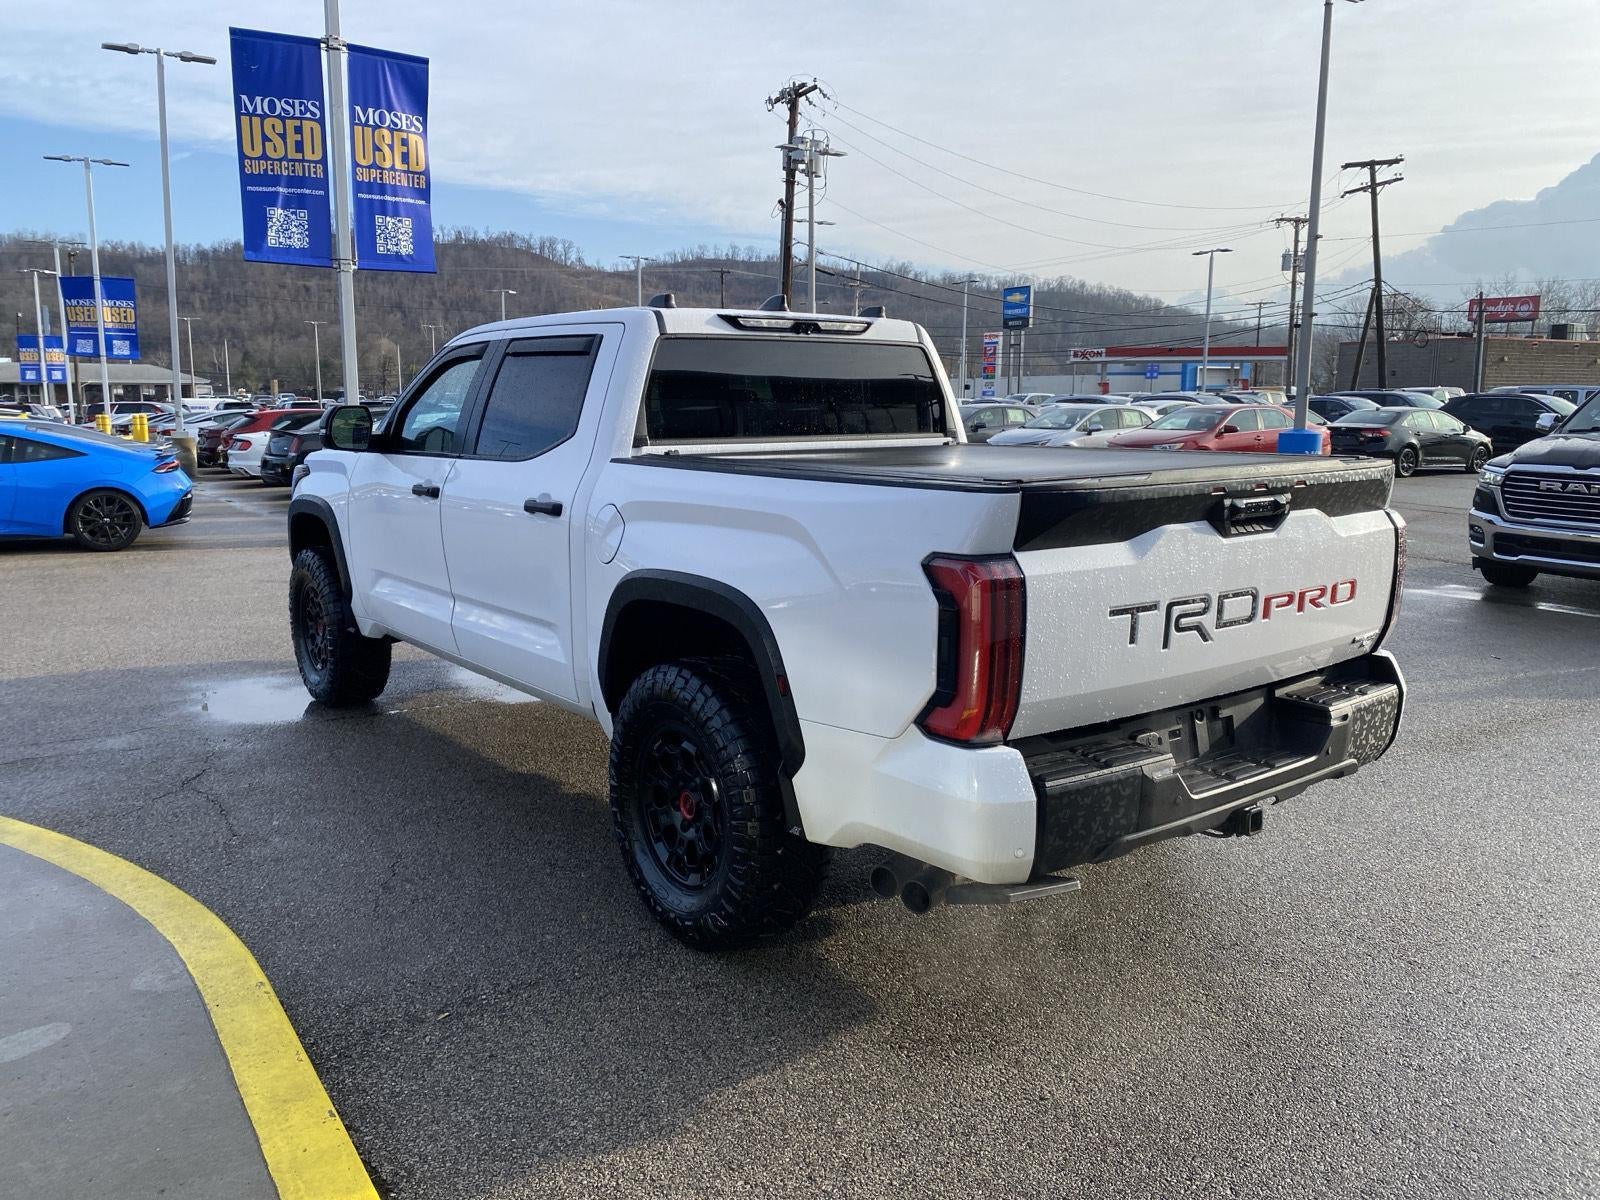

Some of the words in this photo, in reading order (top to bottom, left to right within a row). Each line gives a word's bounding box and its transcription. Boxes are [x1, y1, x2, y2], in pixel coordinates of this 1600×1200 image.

[240, 94, 321, 119] MOSES
[353, 105, 423, 133] MOSES
[240, 115, 323, 161] USED
[353, 125, 426, 173] USED
[244, 159, 324, 179] SUPERCENTER
[356, 167, 426, 189] SUPERCENTER
[246, 185, 325, 196] mosesusedsupercenter.com
[357, 192, 427, 206] mosesusedsupercenter.com
[102, 299, 135, 308] MOSES
[66, 306, 97, 322] USED
[102, 306, 136, 323] USED
[1072, 349, 1103, 361] EXXON
[1108, 586, 1258, 651] TRD
[1262, 578, 1358, 622] PRO
